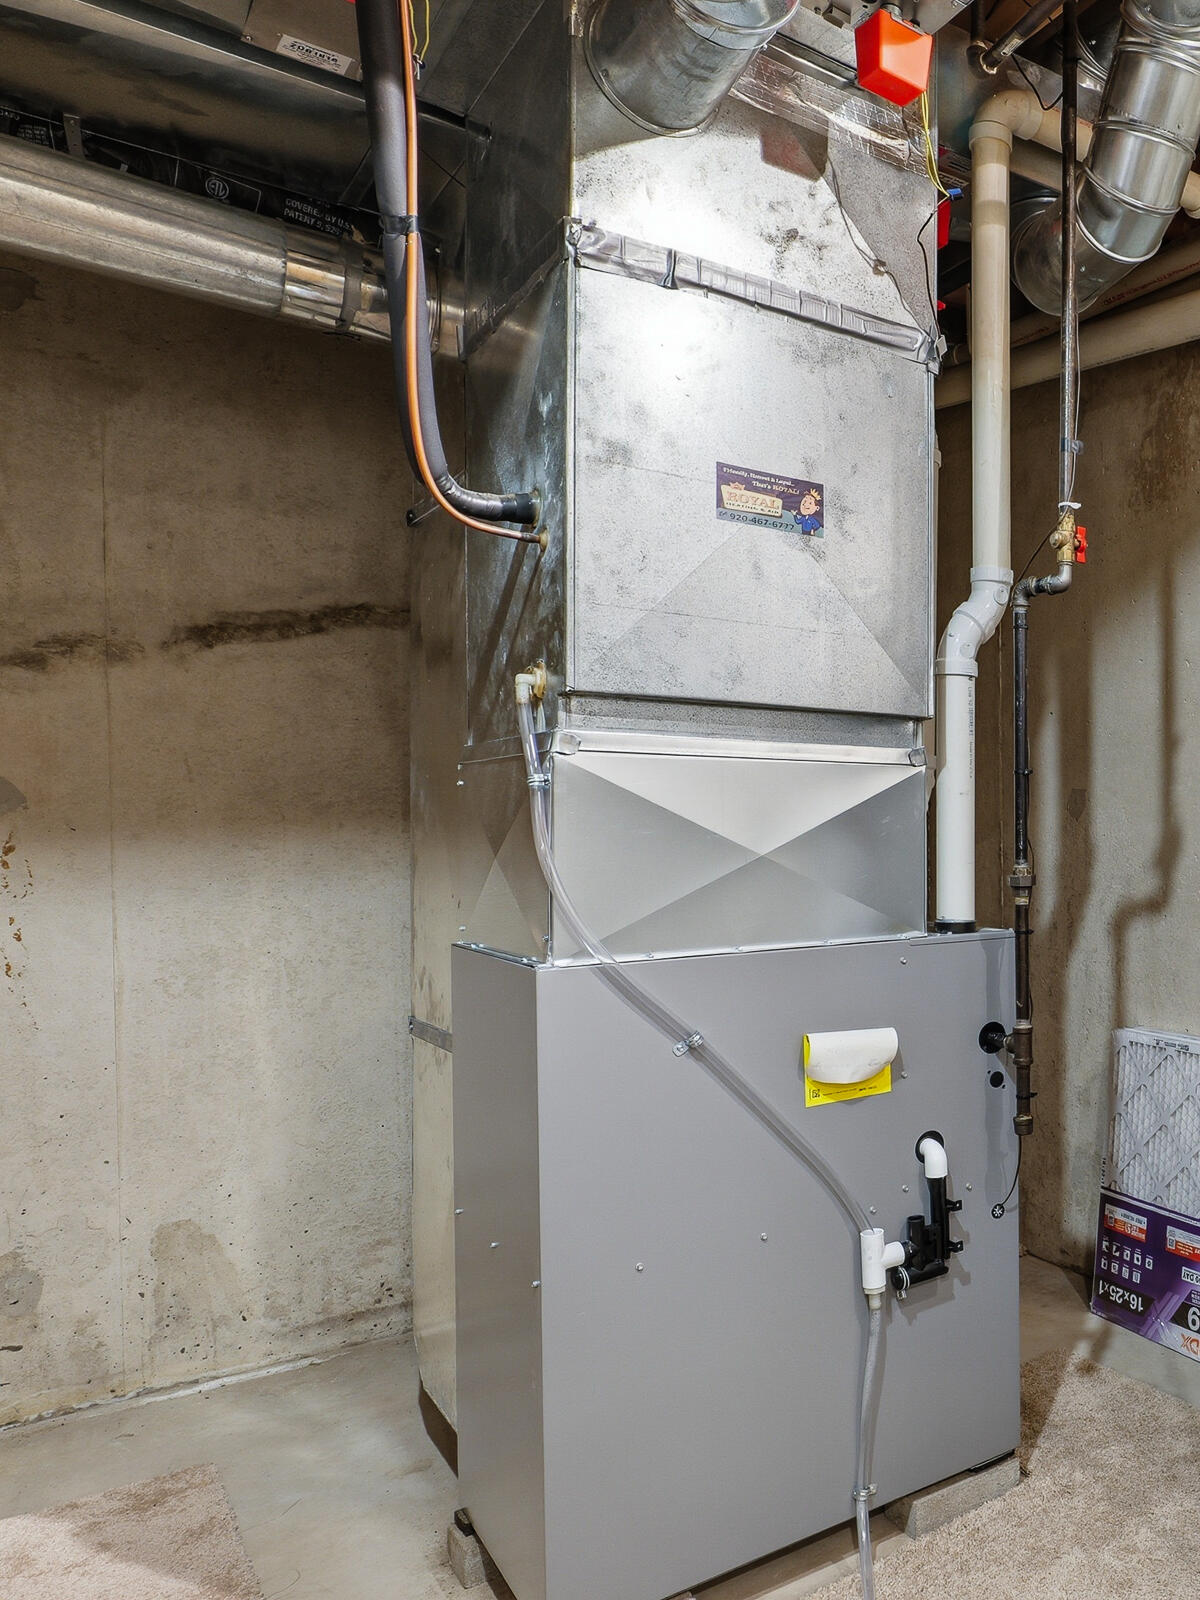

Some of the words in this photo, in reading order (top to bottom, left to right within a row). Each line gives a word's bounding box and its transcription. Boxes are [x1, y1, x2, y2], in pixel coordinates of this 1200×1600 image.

[727, 490, 779, 509] ROYAL
[730, 513, 795, 530] 920-467-6777
[1099, 1279, 1144, 1313] 16x25x1
[1187, 1306, 1200, 1331] 9
